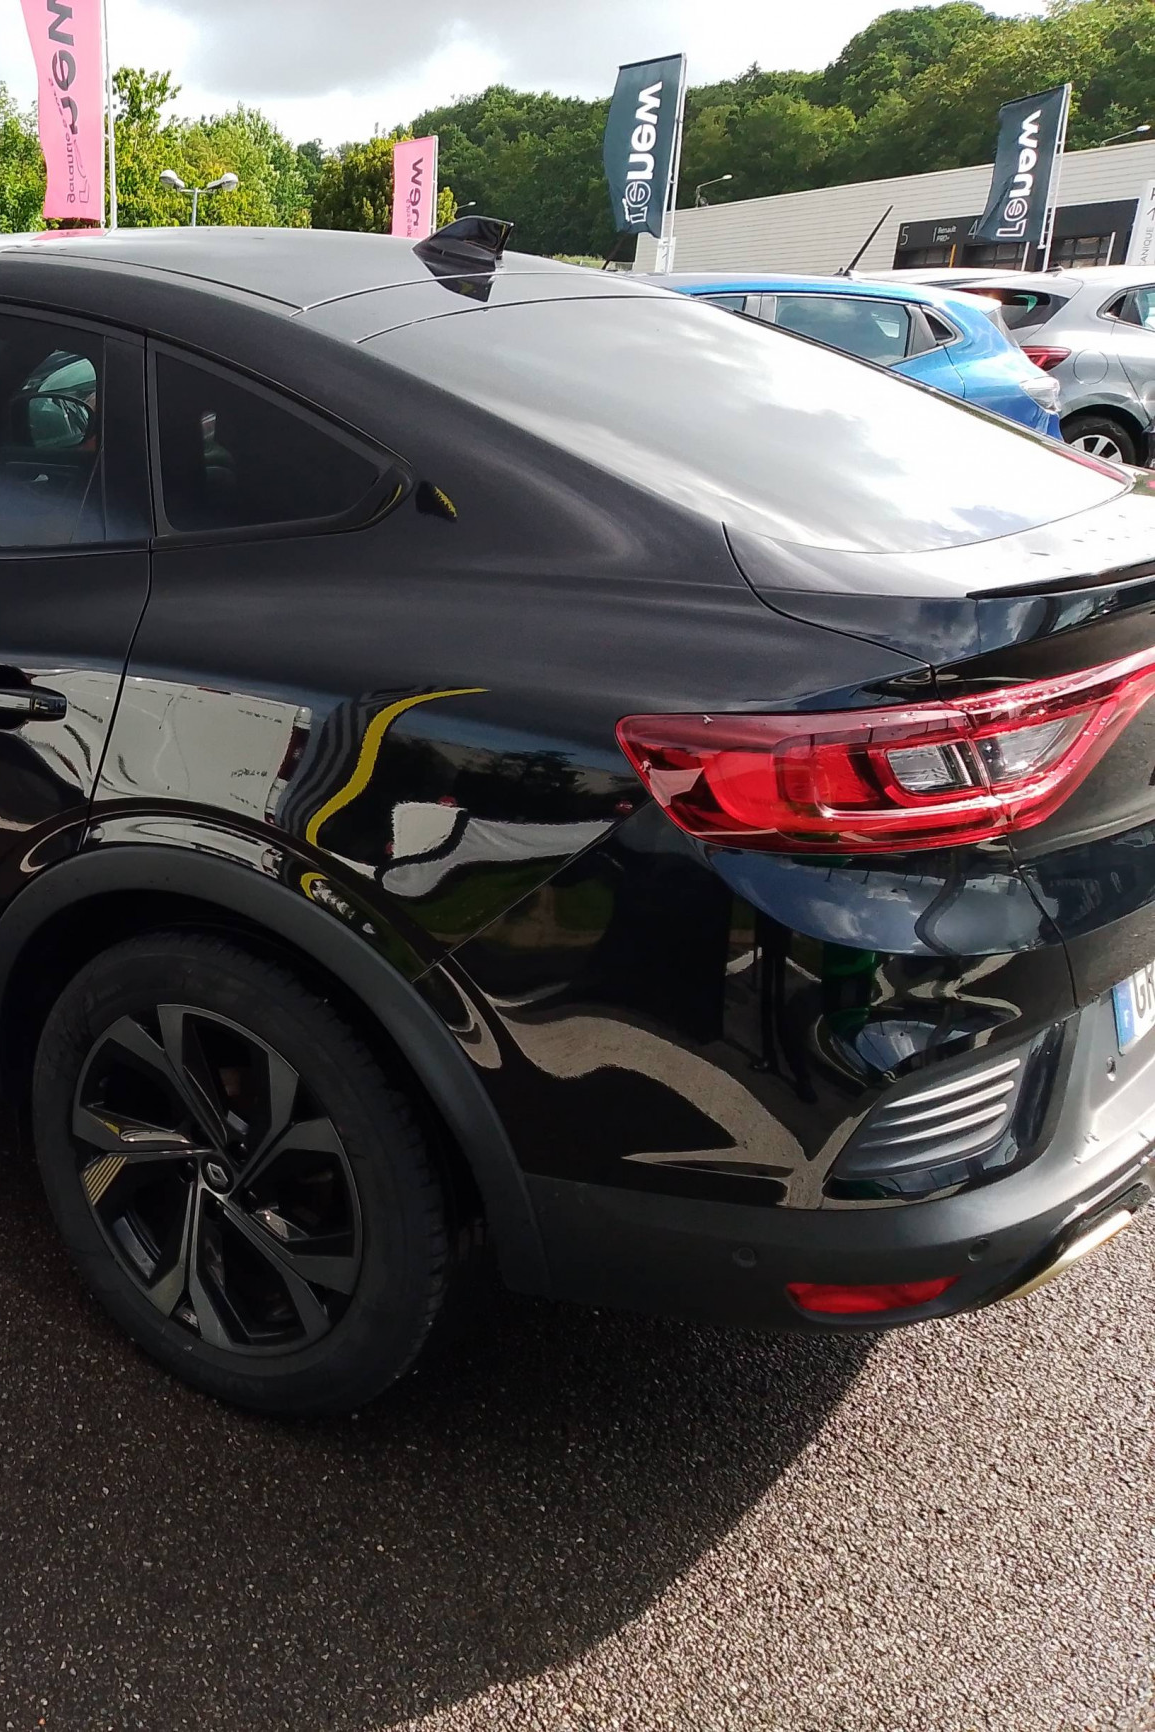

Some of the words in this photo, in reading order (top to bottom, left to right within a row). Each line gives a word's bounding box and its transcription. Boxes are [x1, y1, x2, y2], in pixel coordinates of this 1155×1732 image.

[899, 225, 910, 246] 5
[967, 219, 979, 240] 4
[1140, 226, 1154, 263] ANIQUE
